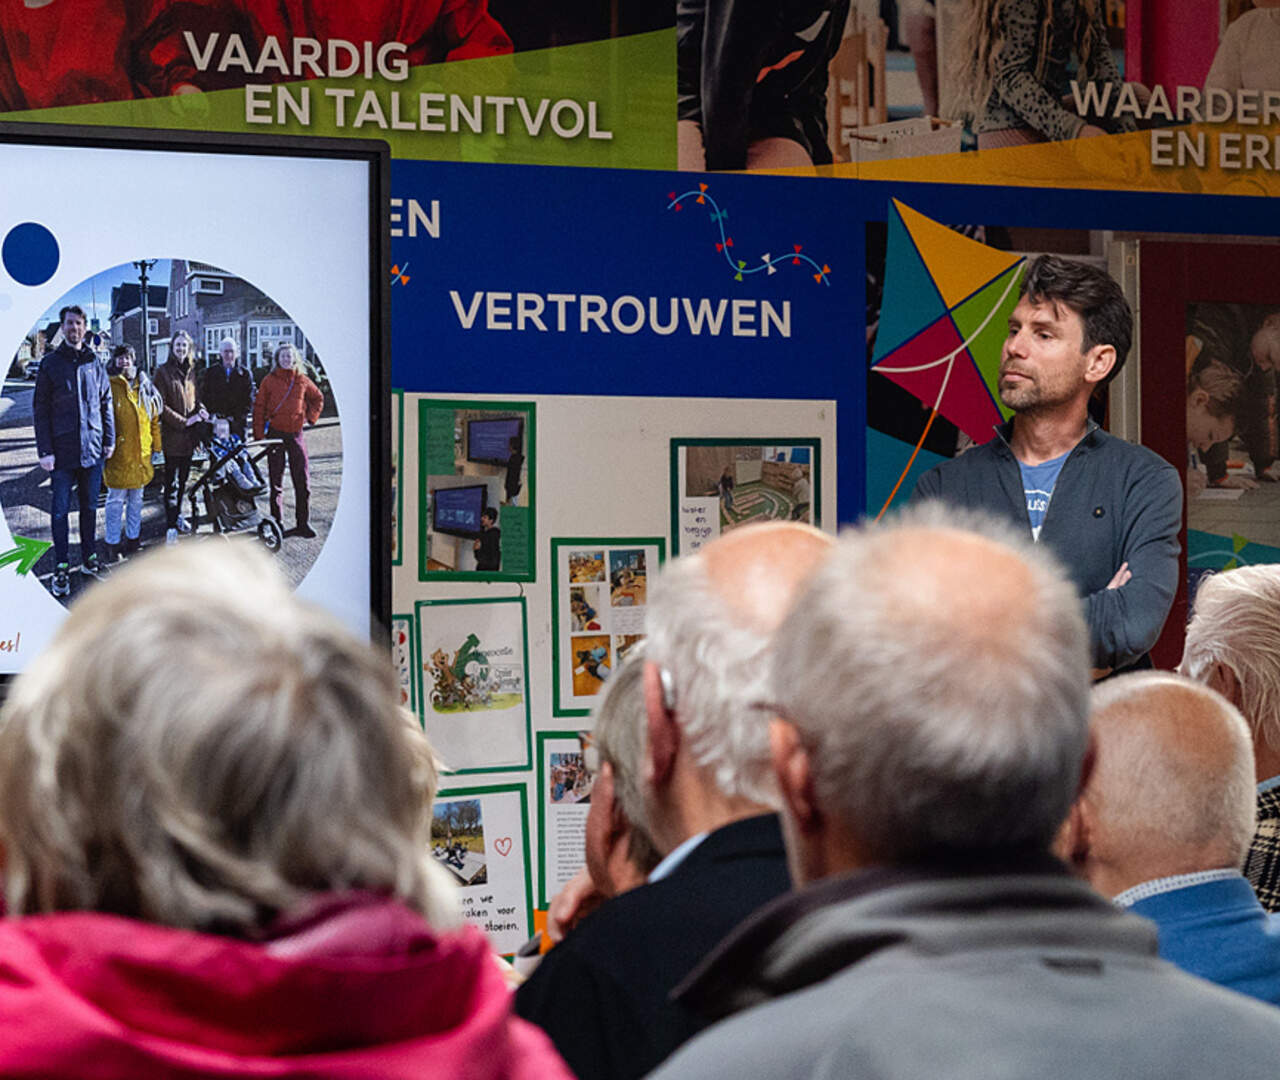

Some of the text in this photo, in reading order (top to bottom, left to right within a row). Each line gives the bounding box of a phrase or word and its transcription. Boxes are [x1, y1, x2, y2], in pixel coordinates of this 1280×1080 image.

[184, 30, 410, 82] VAARDIG
[245, 84, 613, 140] EN TALENTVOL
[1150, 130, 1206, 168] EN
[449, 290, 792, 339] VERTROUWEN
[480, 895, 493, 903] we
